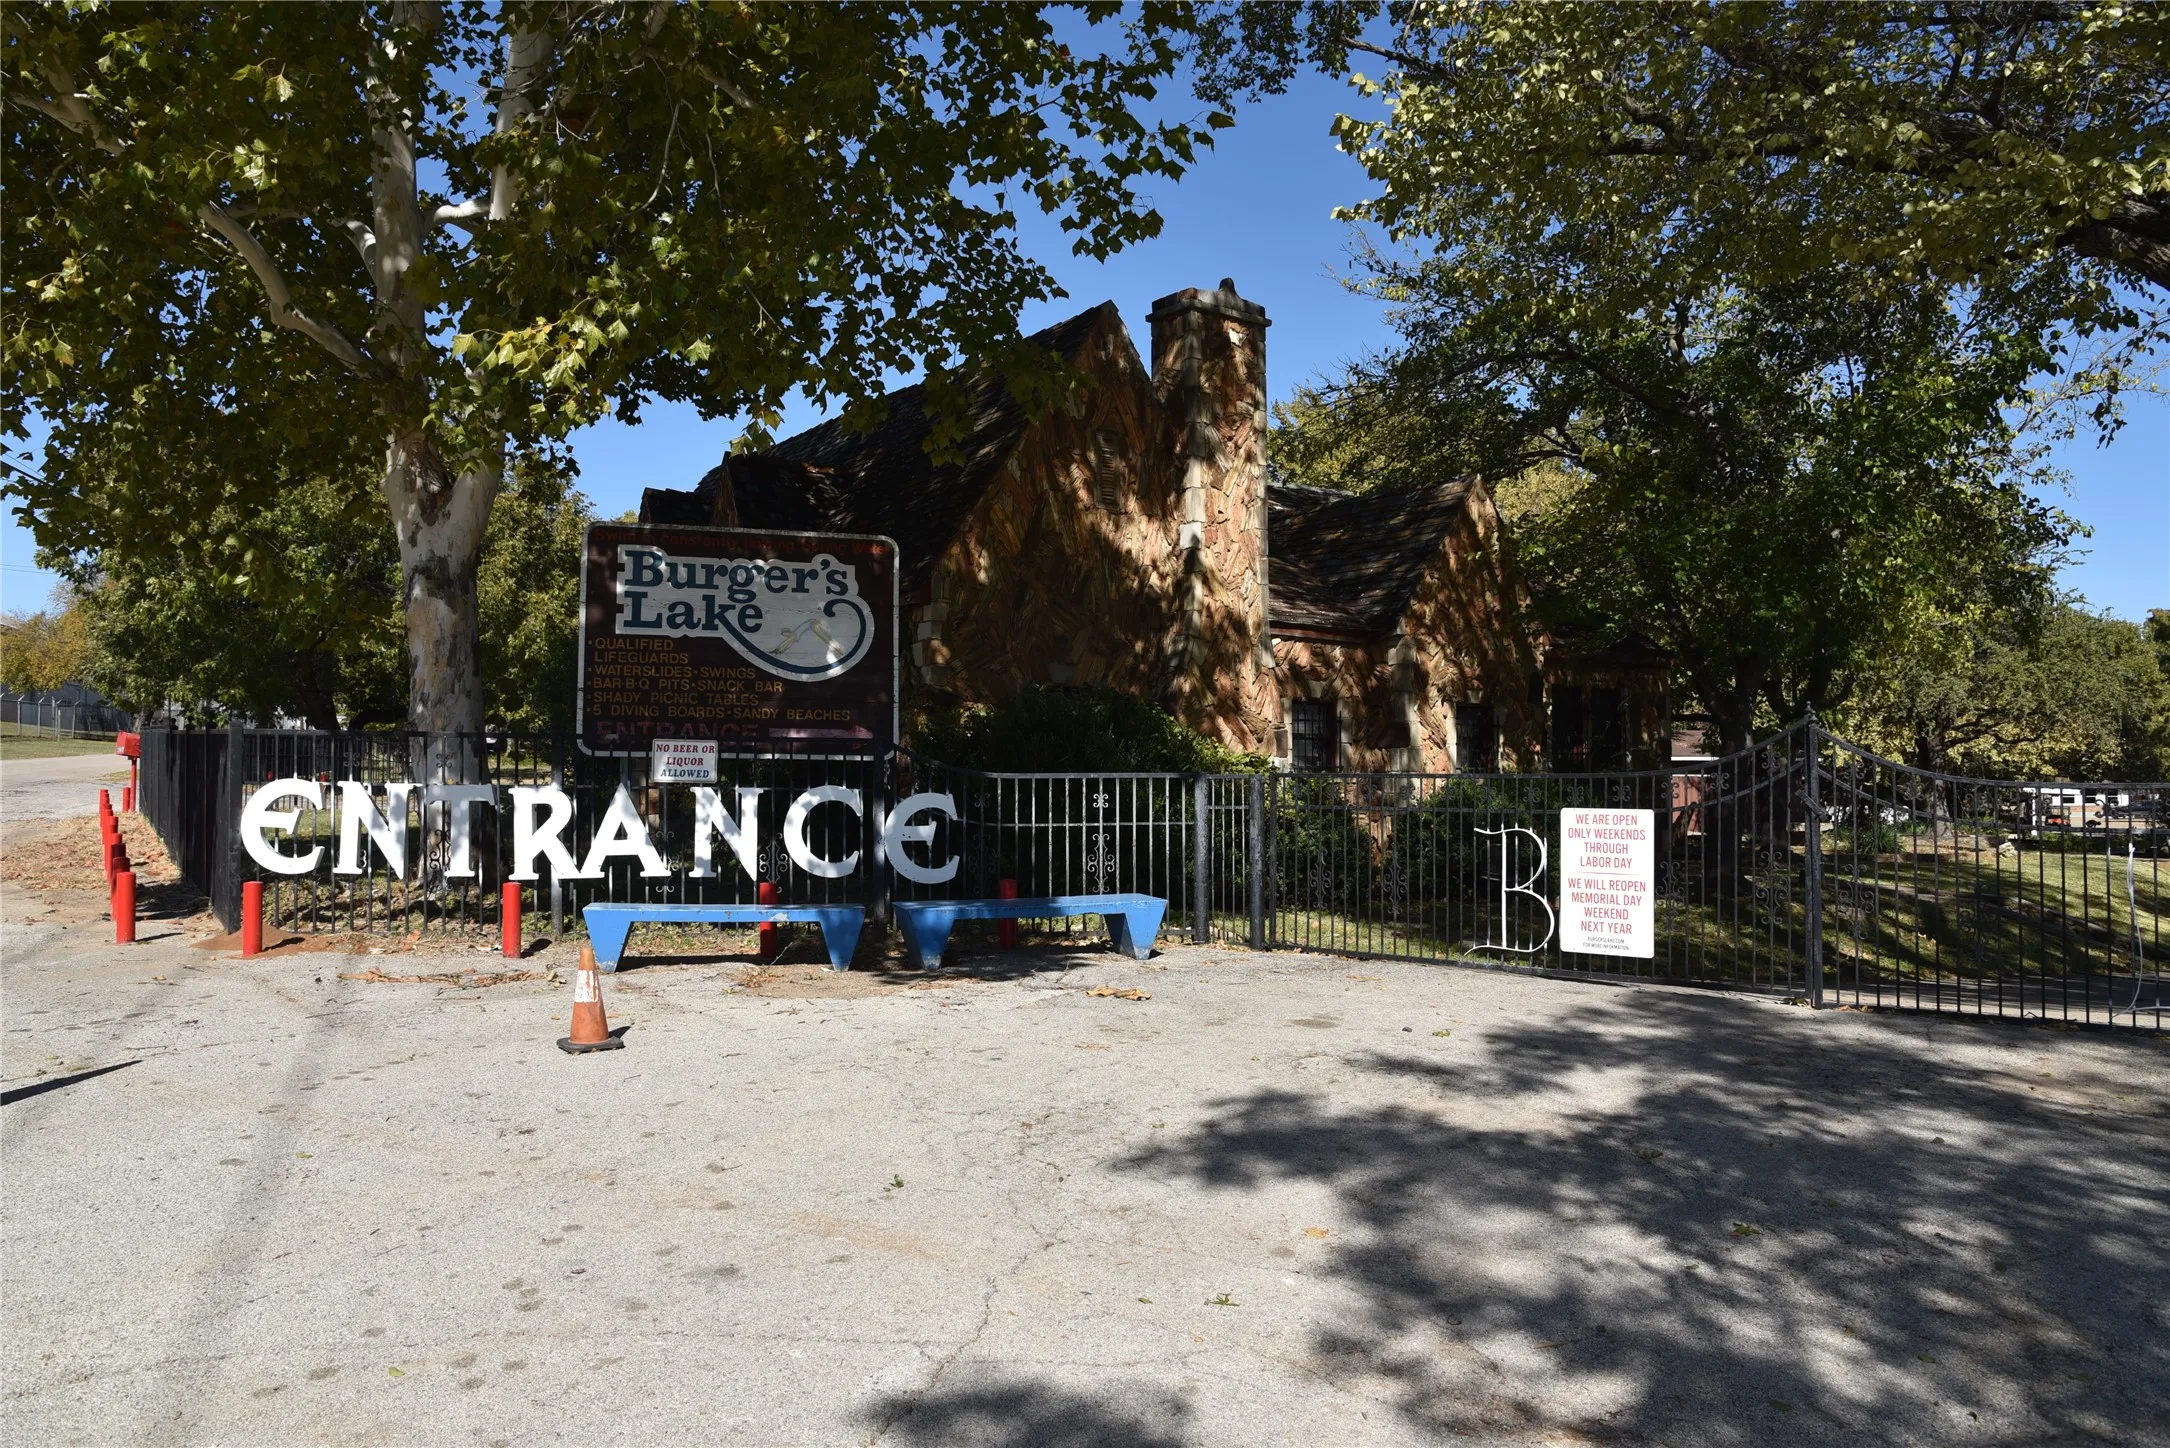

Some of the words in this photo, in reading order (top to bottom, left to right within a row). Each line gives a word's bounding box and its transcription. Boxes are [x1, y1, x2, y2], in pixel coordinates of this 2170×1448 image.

[595, 529, 636, 541] Swim
[625, 550, 849, 603] Burger's
[623, 590, 764, 634] Lake
[595, 637, 674, 651] QUALIFIED
[594, 651, 689, 664] LIFEGUARDS
[594, 665, 693, 678] WATERSLIDES
[700, 667, 756, 680] SWINGS
[658, 678, 690, 690] PITS
[697, 679, 745, 692] SNACK
[755, 681, 784, 693] BAR
[593, 691, 642, 703] SHADY
[650, 691, 699, 705] PICNIC
[705, 693, 759, 706] TABLES
[592, 704, 602, 716] 5
[611, 704, 660, 717] DIVING
[668, 705, 725, 718] BOARDS
[733, 706, 779, 719] SANDY
[787, 708, 850, 721] BEACHES
[596, 721, 759, 746] ENTRANCE
[656, 744, 670, 753] NO
[673, 744, 699, 753] BEER
[702, 745, 715, 754] OR
[666, 757, 704, 767] LIQUOR
[660, 769, 710, 778] ALLOWED
[1575, 813, 1590, 825] WE
[1592, 813, 1610, 825] ARE
[1612, 814, 1638, 826] OPEN
[240, 777, 961, 884] ENTRANCE
[1568, 827, 1591, 839] ONLY
[1594, 828, 1646, 841] WEEKENDS
[1584, 841, 1629, 854] THROUGH
[1580, 855, 1612, 868] LABOR
[1613, 857, 1633, 868] DAY
[1568, 877, 1582, 889] WE
[1584, 878, 1606, 890] WILL
[1609, 879, 1646, 892] REOPEN
[1571, 891, 1621, 906] MEMORIAL
[1623, 894, 1642, 906] DAY
[1584, 906, 1629, 920] WEEKEND
[1580, 920, 1605, 932] NEXT
[1607, 922, 1633, 935] YEAR
